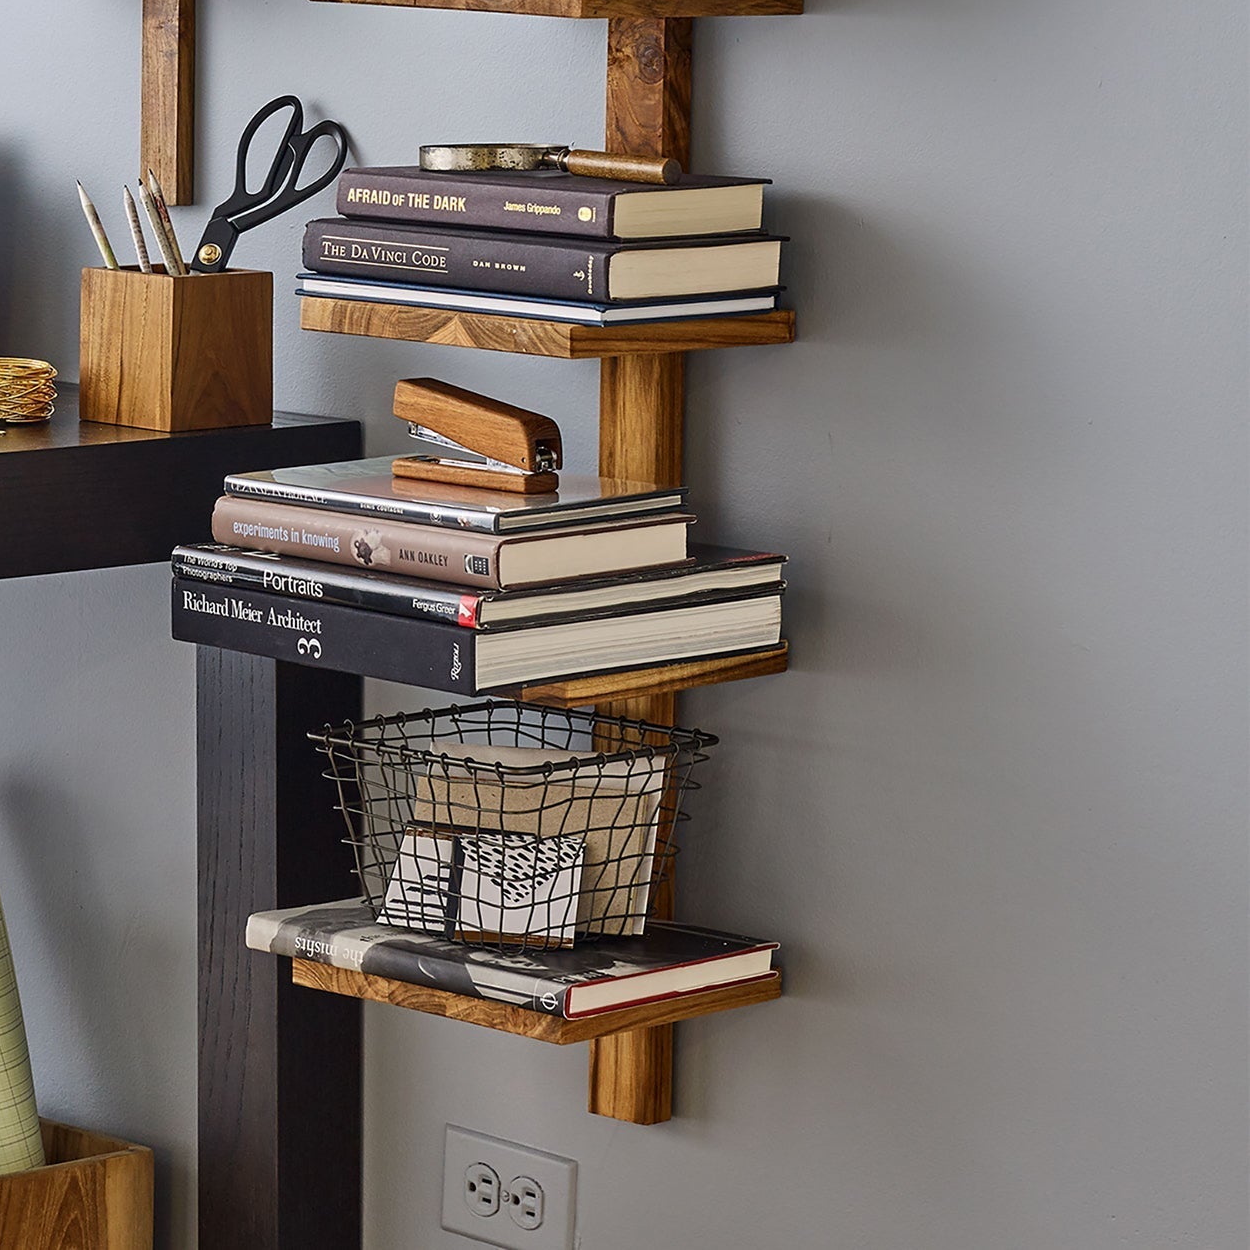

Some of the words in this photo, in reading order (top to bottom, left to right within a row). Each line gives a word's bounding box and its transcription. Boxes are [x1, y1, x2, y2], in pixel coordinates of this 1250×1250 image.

[346, 187, 391, 206] AFRAID
[392, 195, 405, 207] OF
[407, 192, 430, 209] THE
[433, 195, 467, 212] DARK
[503, 201, 526, 213] James
[526, 202, 561, 216] Grippando
[472, 260, 491, 269] DAN
[494, 261, 526, 272] BROWN
[233, 521, 289, 542] experiments
[290, 527, 300, 544] in
[301, 529, 340, 553] knowing
[399, 548, 416, 562] ANN
[417, 551, 449, 567] OAKLEY
[182, 566, 233, 583] Photographers
[183, 554, 196, 566] The
[224, 560, 238, 573] Top
[262, 568, 324, 598] Portraits
[412, 598, 436, 613] Fergus
[182, 590, 229, 618] Richard
[230, 598, 263, 624] Meier
[266, 606, 322, 635] Architect
[297, 637, 322, 660] 3
[294, 936, 338, 958] misfits
[342, 949, 364, 968] the
